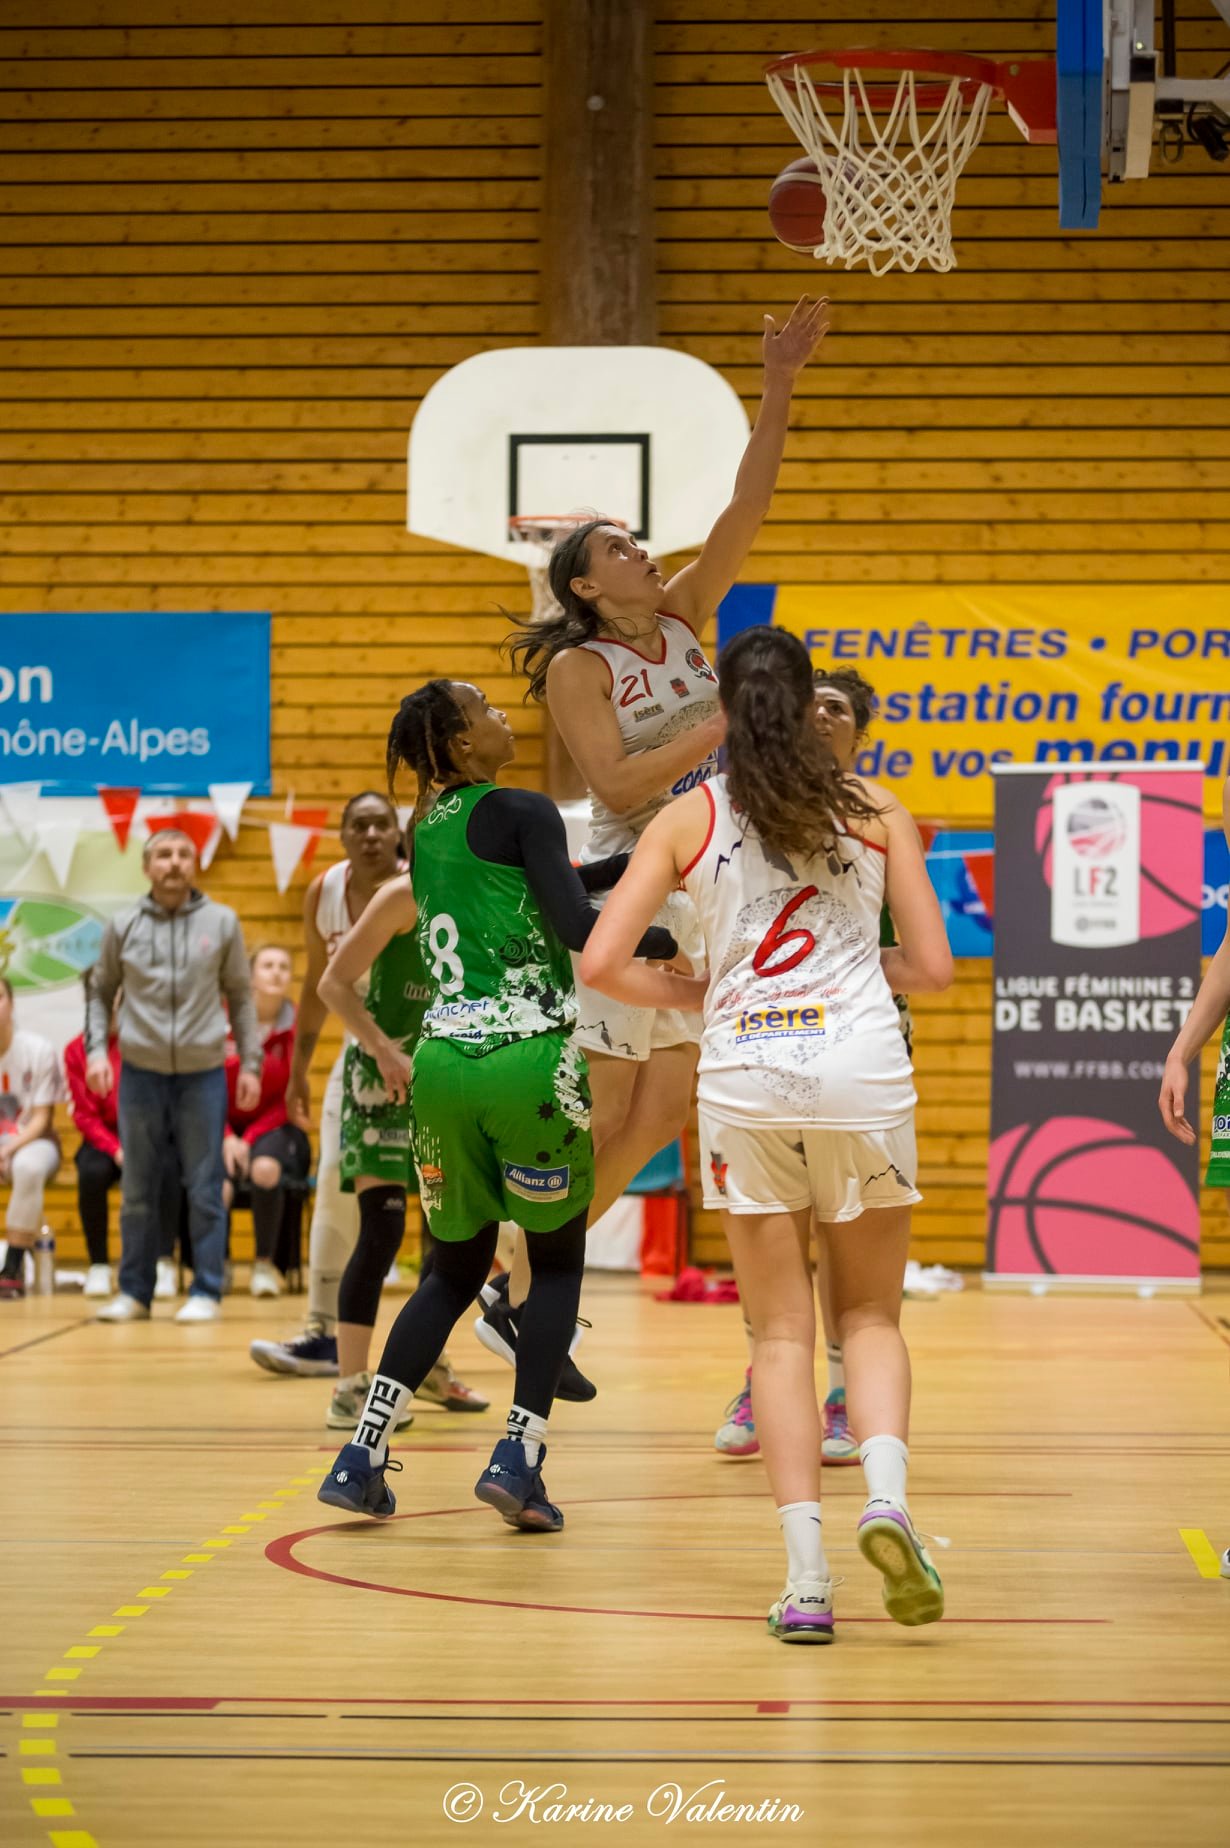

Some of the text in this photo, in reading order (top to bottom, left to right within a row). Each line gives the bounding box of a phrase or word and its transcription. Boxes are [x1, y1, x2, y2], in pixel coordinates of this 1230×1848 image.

[804, 621, 1230, 659] FENÊTRES POR
[619, 669, 653, 708] 21
[871, 682, 1078, 722] station
[855, 741, 913, 777] de
[1035, 739, 1230, 777] menu
[1074, 867, 1117, 896] LF2
[751, 885, 818, 977] 6
[430, 912, 465, 996] 8
[996, 973, 1193, 997] LIGUE FÉMININE 2
[740, 1005, 819, 1032] isère
[996, 1000, 1193, 1031] DE BASKET
[509, 1168, 545, 1187] Allianz
